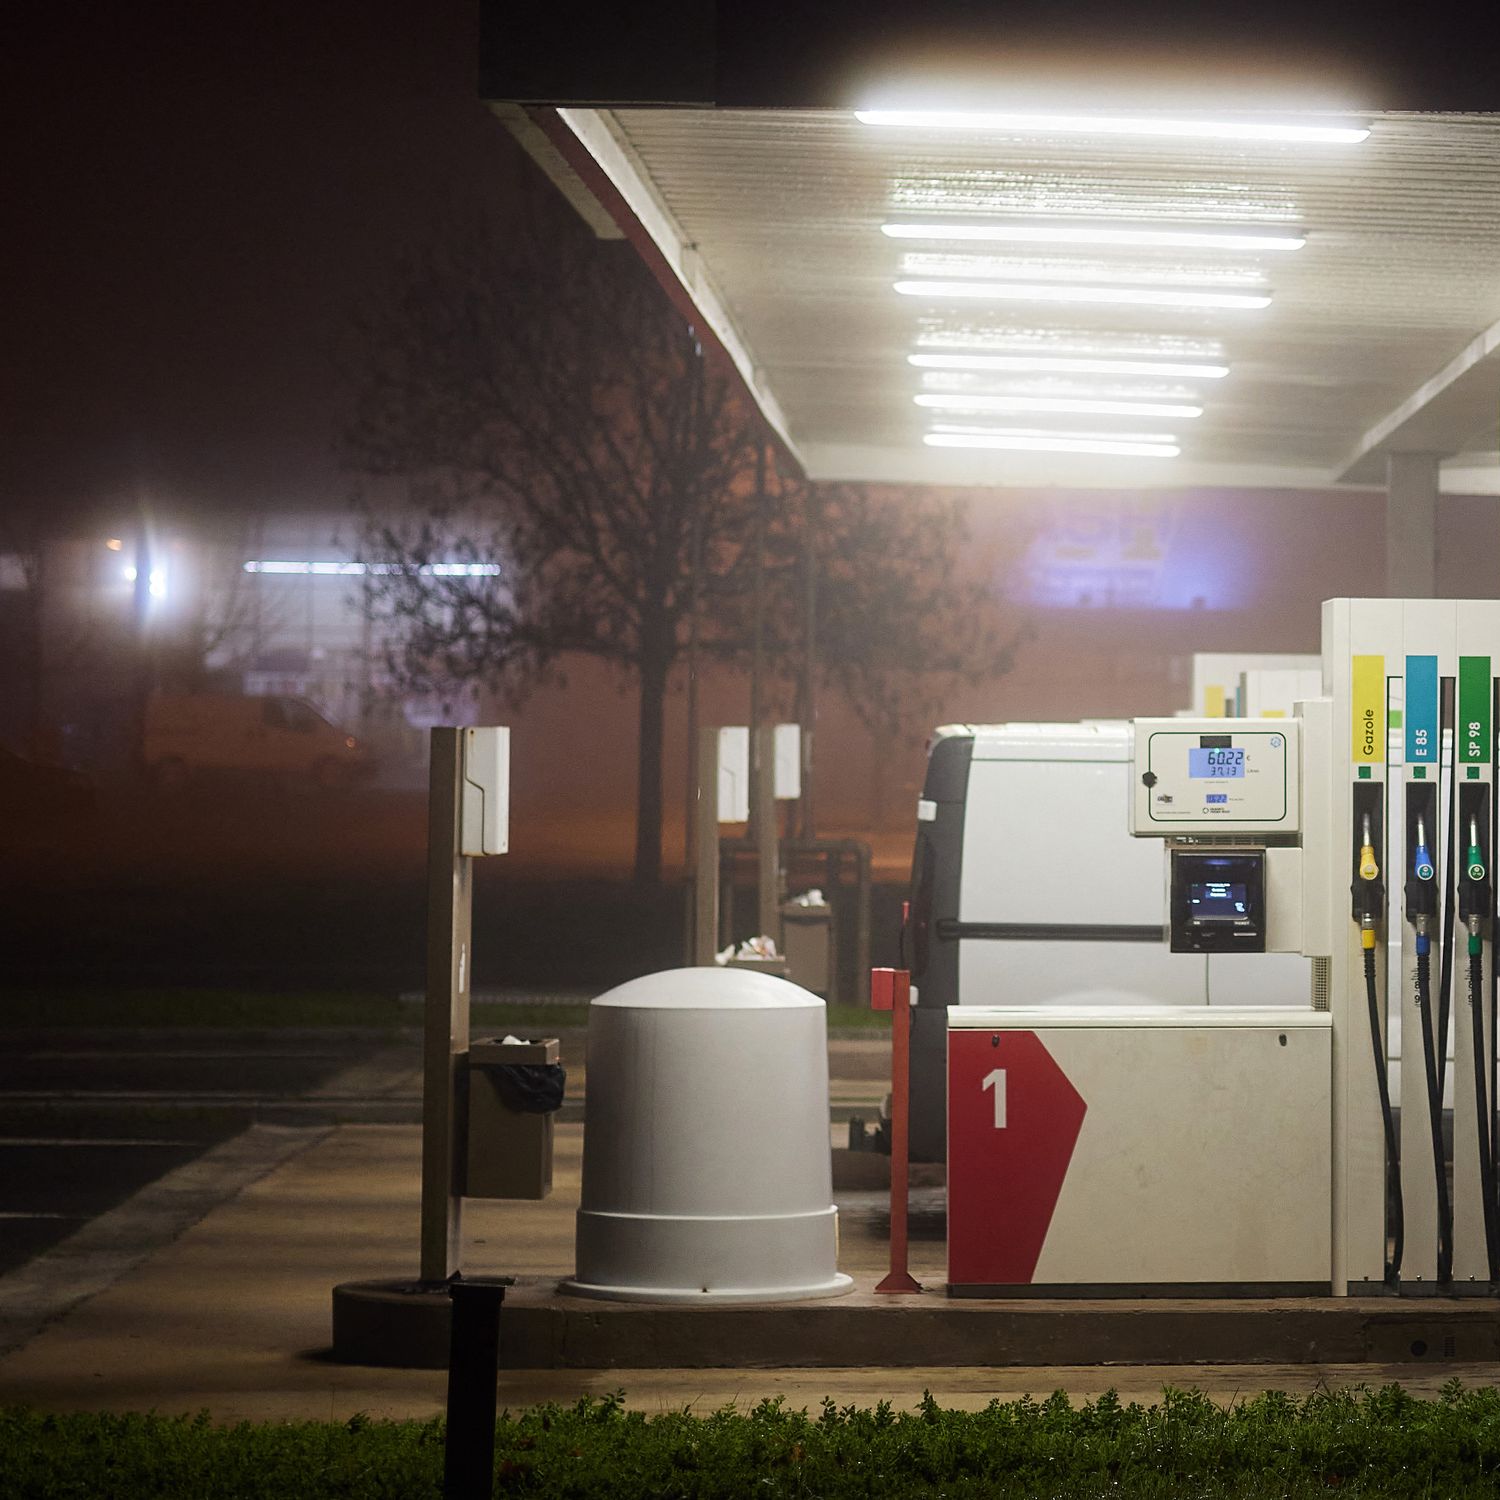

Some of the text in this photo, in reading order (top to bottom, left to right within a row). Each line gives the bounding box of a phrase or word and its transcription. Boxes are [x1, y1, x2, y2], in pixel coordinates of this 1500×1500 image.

[1363, 709, 1374, 756] Gazole
[1416, 729, 1427, 756] E 85
[1469, 721, 1480, 756] SP 98
[982, 1069, 1007, 1129] 1
